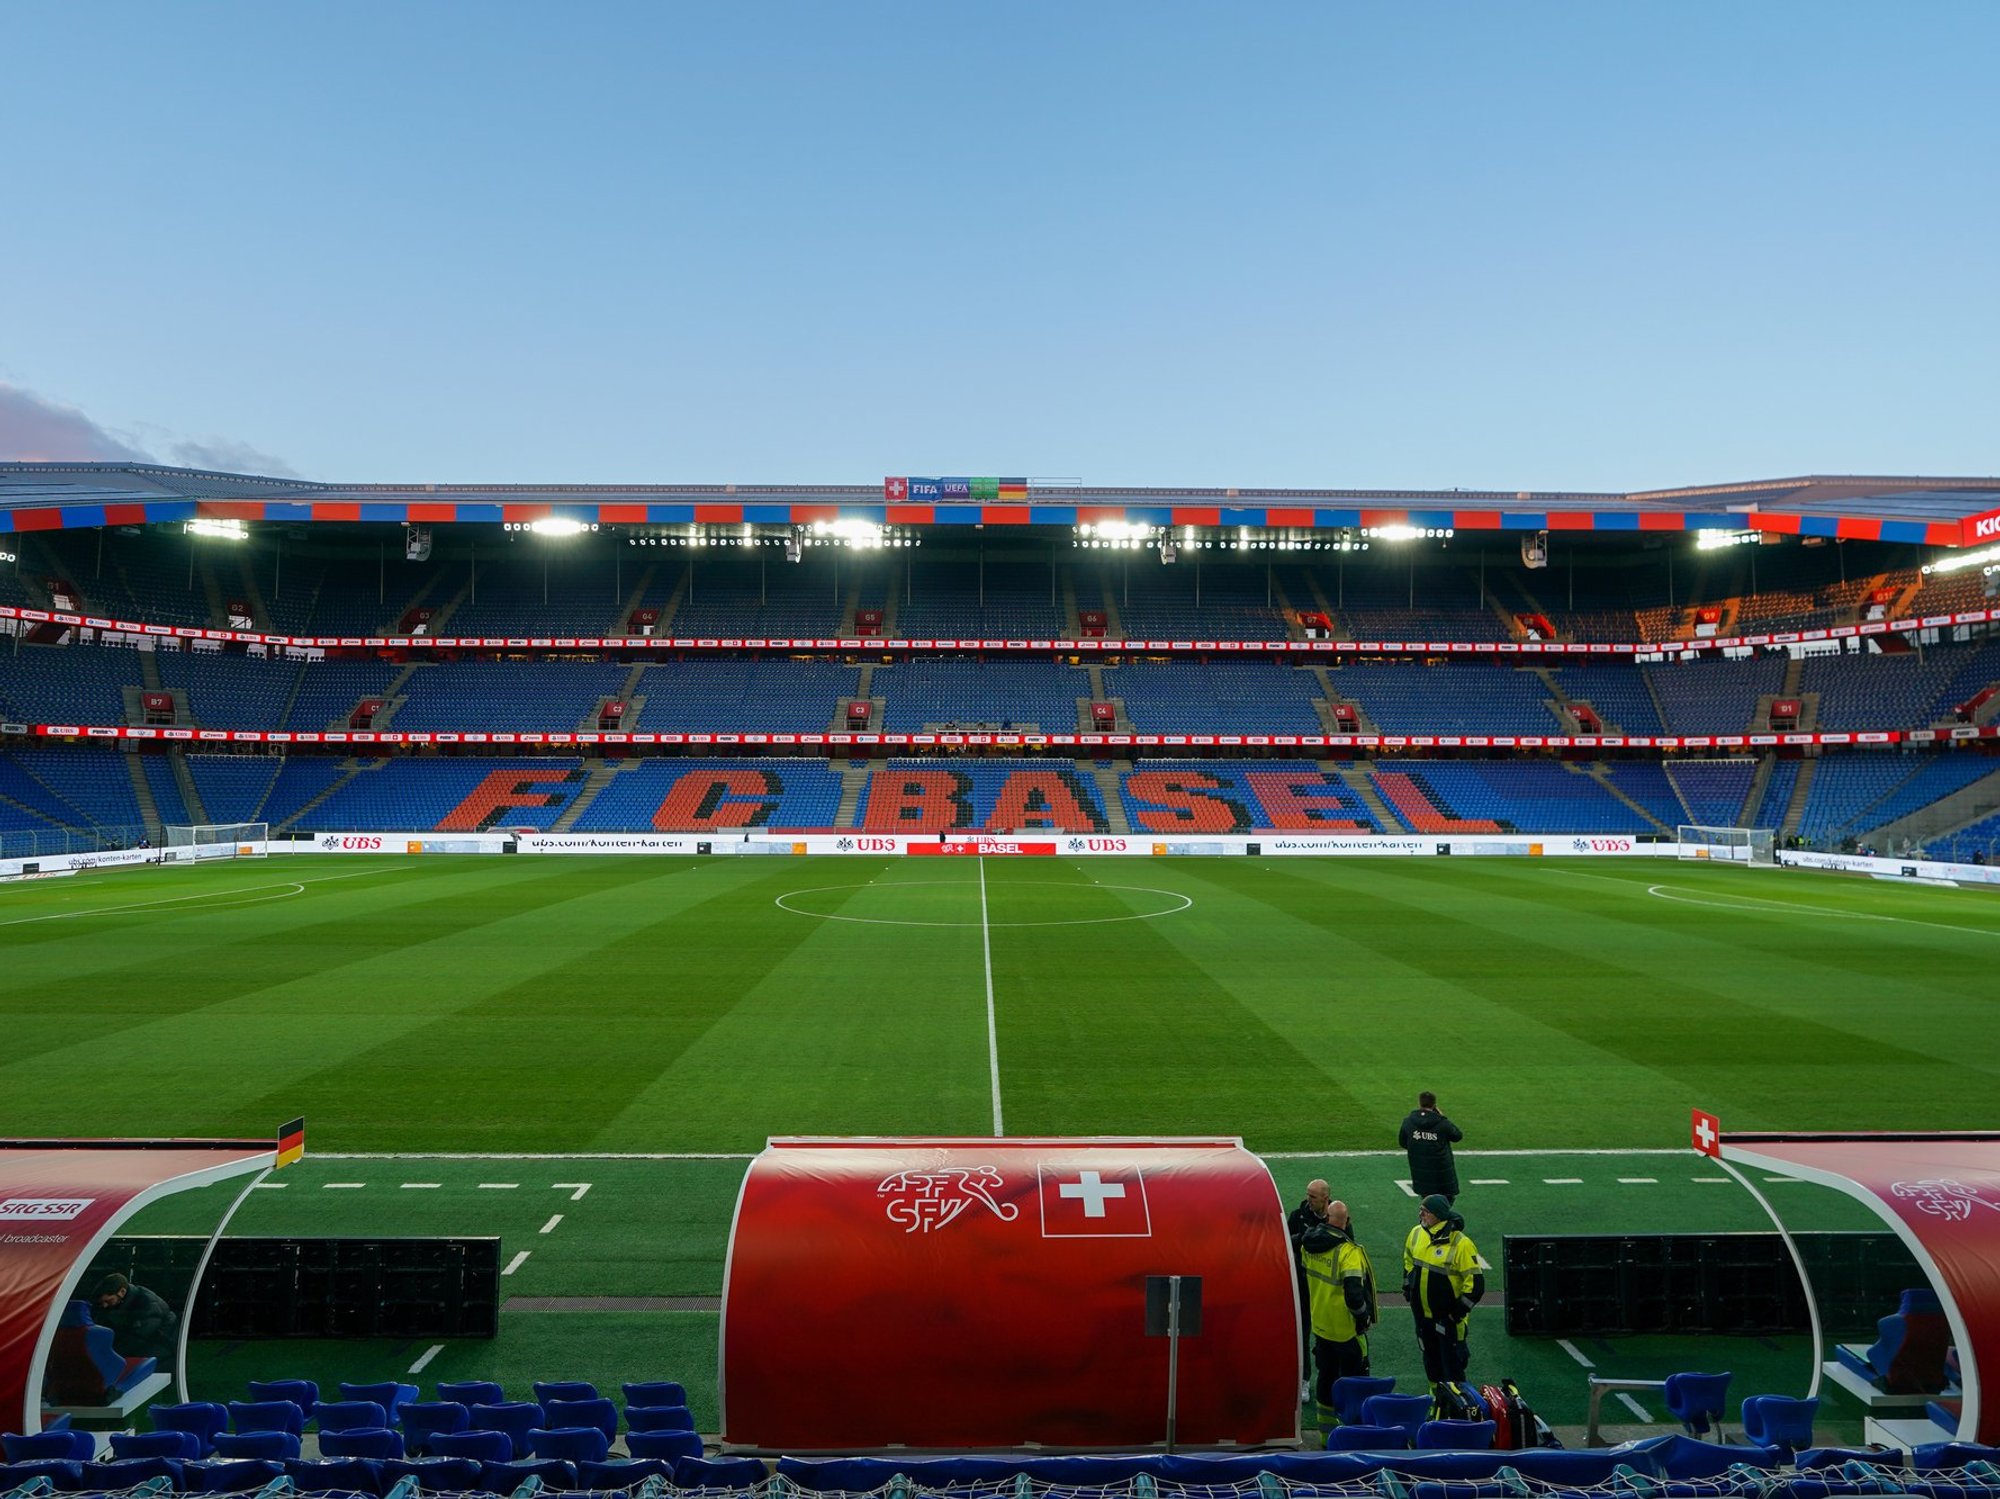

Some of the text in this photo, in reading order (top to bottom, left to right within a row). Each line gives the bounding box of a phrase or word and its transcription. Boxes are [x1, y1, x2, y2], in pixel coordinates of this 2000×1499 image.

[913, 484, 938, 495] FIFA
[945, 483, 968, 493] UEFA
[343, 837, 382, 849] UBS
[857, 838, 896, 851] UBS
[978, 843, 1024, 854] BASEL
[1088, 839, 1127, 851] UBS
[1590, 840, 1630, 851] UBS
[1421, 1131, 1438, 1141] UBS
[0, 1203, 81, 1214] SRG SSR
[4, 1233, 70, 1244] broadcaster
